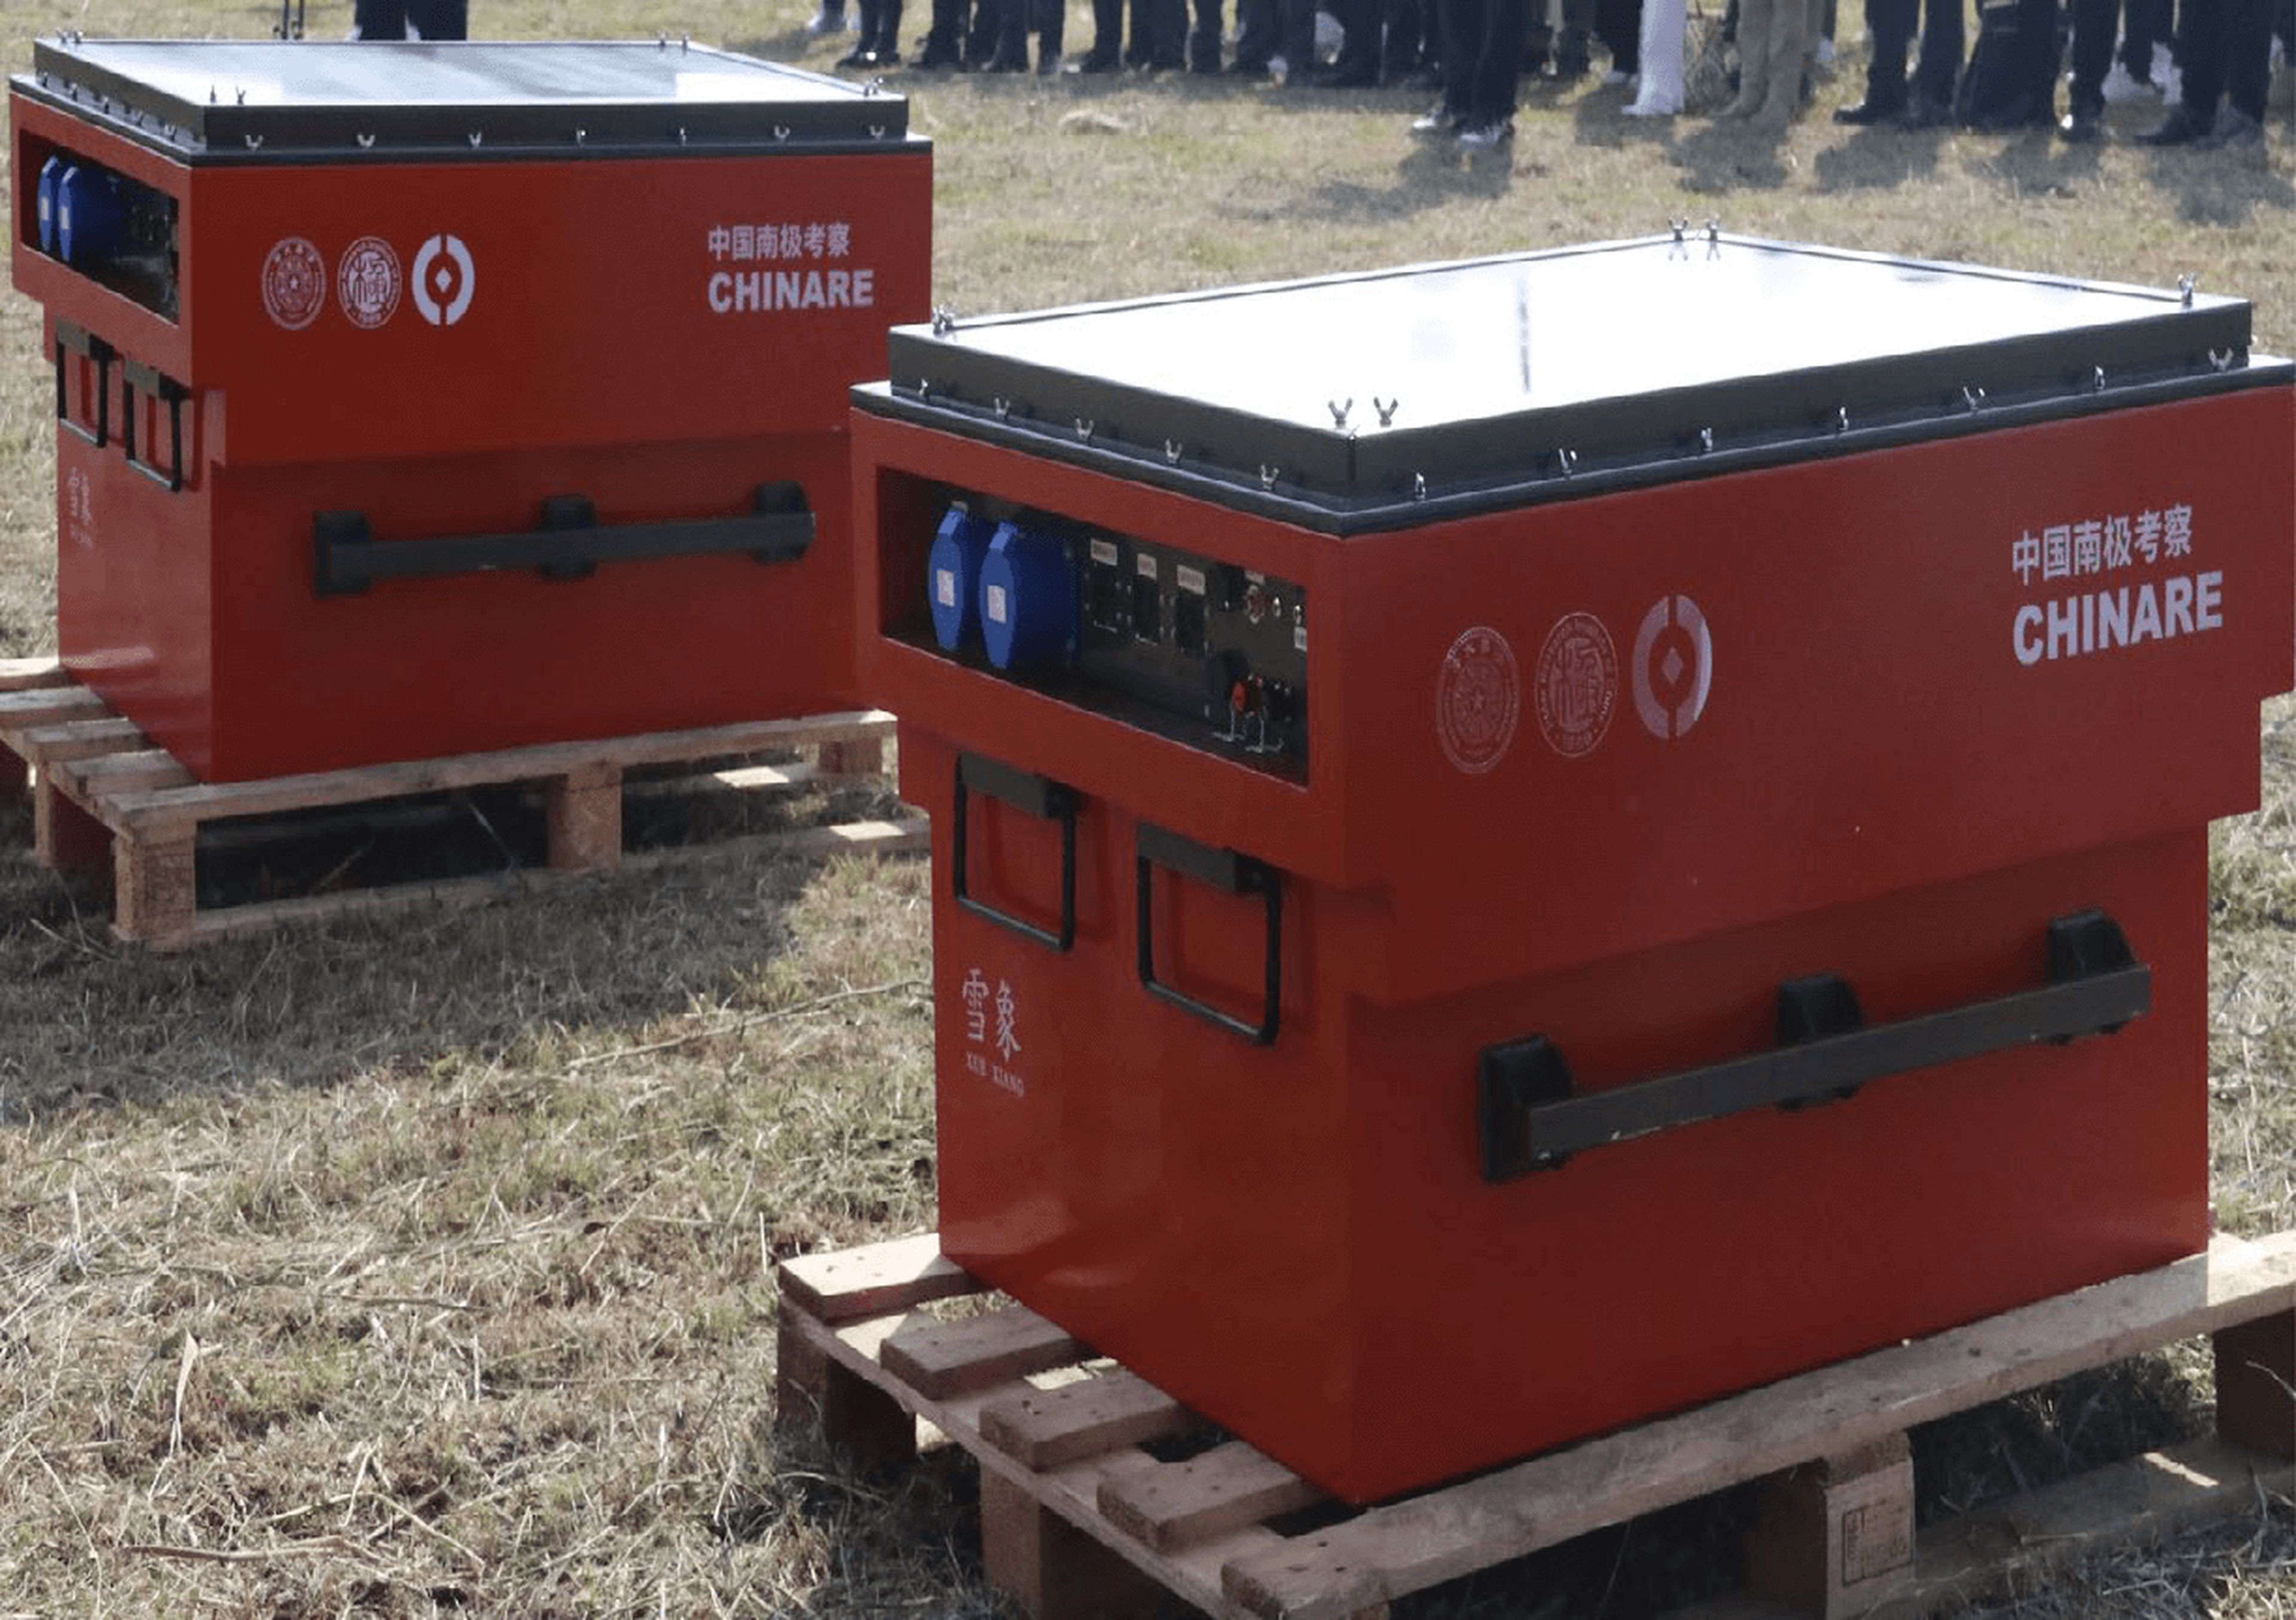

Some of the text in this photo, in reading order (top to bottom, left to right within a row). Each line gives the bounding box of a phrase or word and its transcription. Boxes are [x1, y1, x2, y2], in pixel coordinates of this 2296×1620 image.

[708, 221, 850, 261] 中国南极考察
[708, 269, 874, 313] CHINARE
[2013, 503, 2193, 587] 中国南极考察
[2013, 570, 2224, 666] CHINARE
[961, 968, 1022, 1062] 雪象
